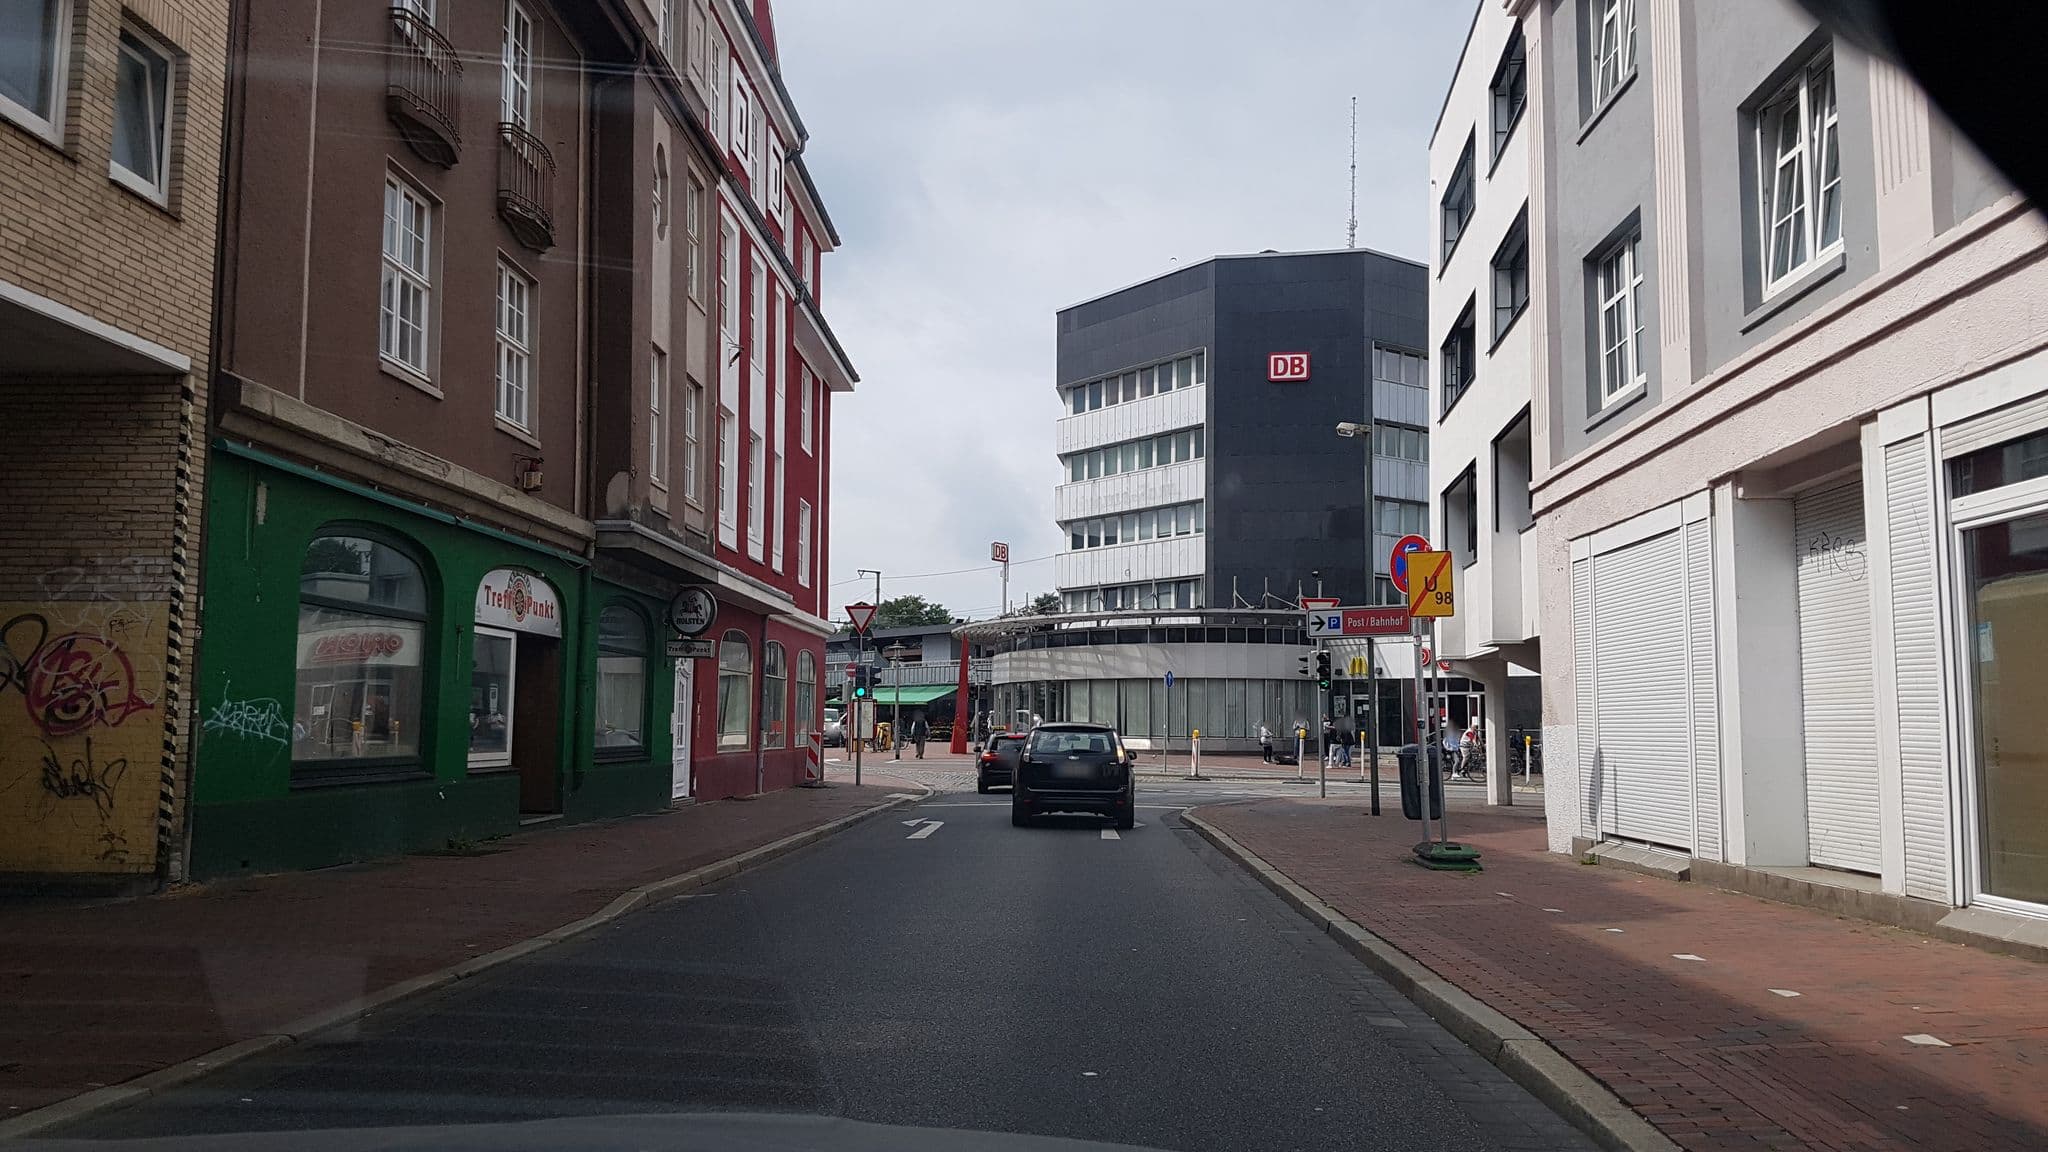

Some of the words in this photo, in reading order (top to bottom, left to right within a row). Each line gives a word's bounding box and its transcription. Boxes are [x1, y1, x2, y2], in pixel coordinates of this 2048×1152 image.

[1273, 356, 1305, 376] DB
[995, 544, 1006, 559] DB
[1425, 576, 1437, 592] U
[1435, 591, 1454, 605] 98
[525, 595, 555, 619] Punkt
[1330, 617, 1338, 628] P
